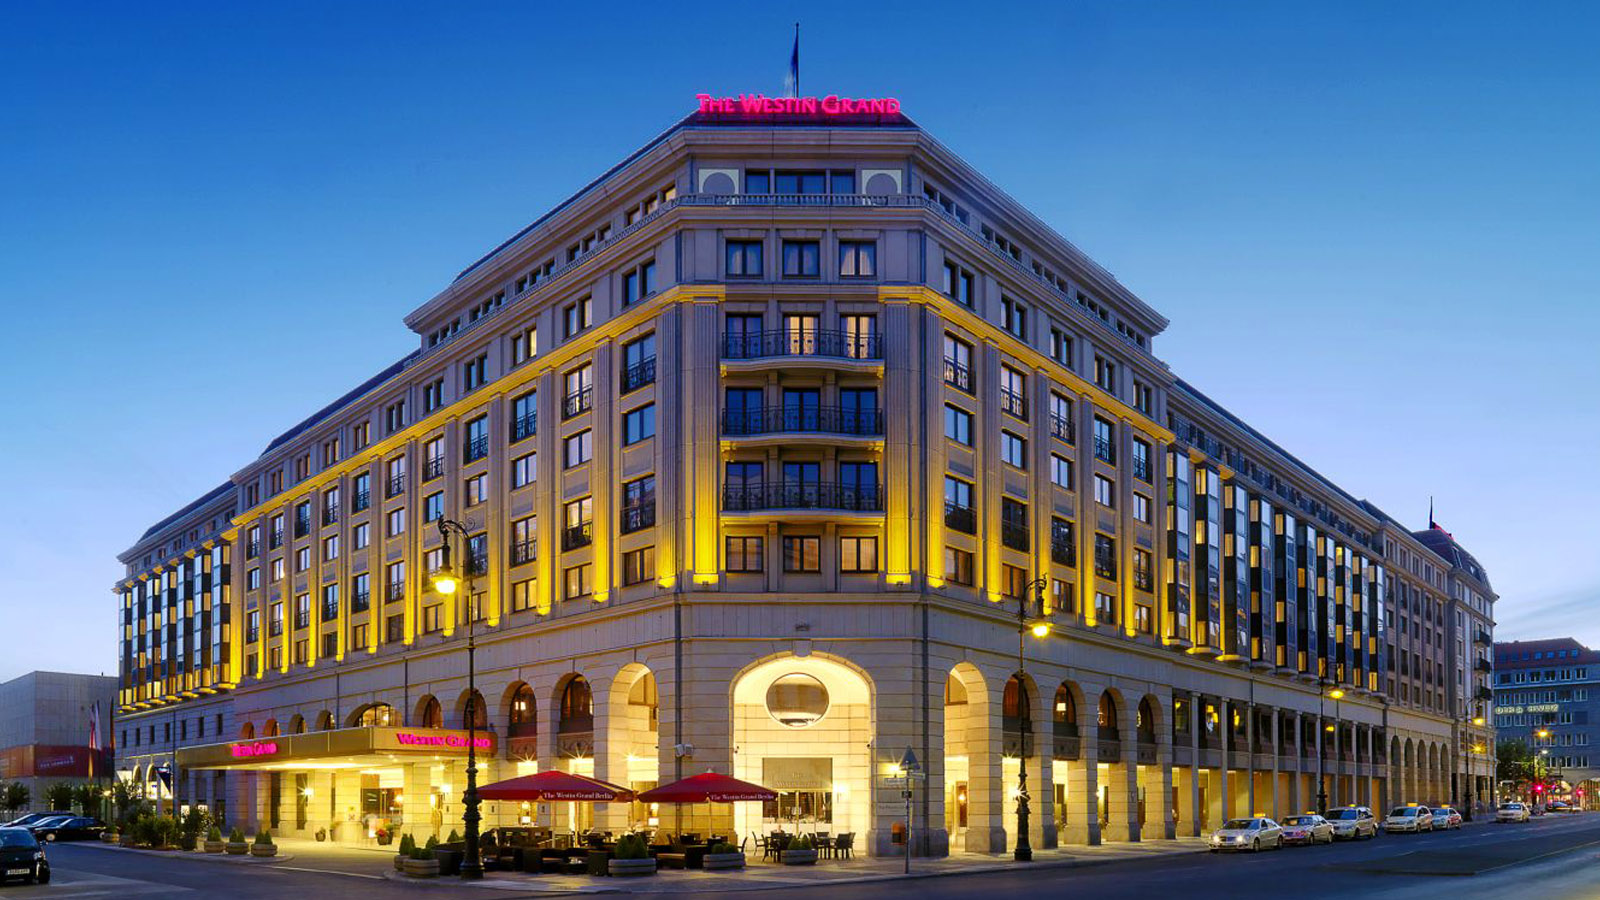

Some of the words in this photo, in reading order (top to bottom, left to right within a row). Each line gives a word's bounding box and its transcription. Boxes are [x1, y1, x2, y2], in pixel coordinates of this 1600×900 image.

[696, 93, 735, 113] THE
[739, 93, 816, 113] WESTIN
[821, 95, 900, 114] GRAND
[396, 732, 445, 746] WESTIN
[595, 792, 613, 800] Berlin
